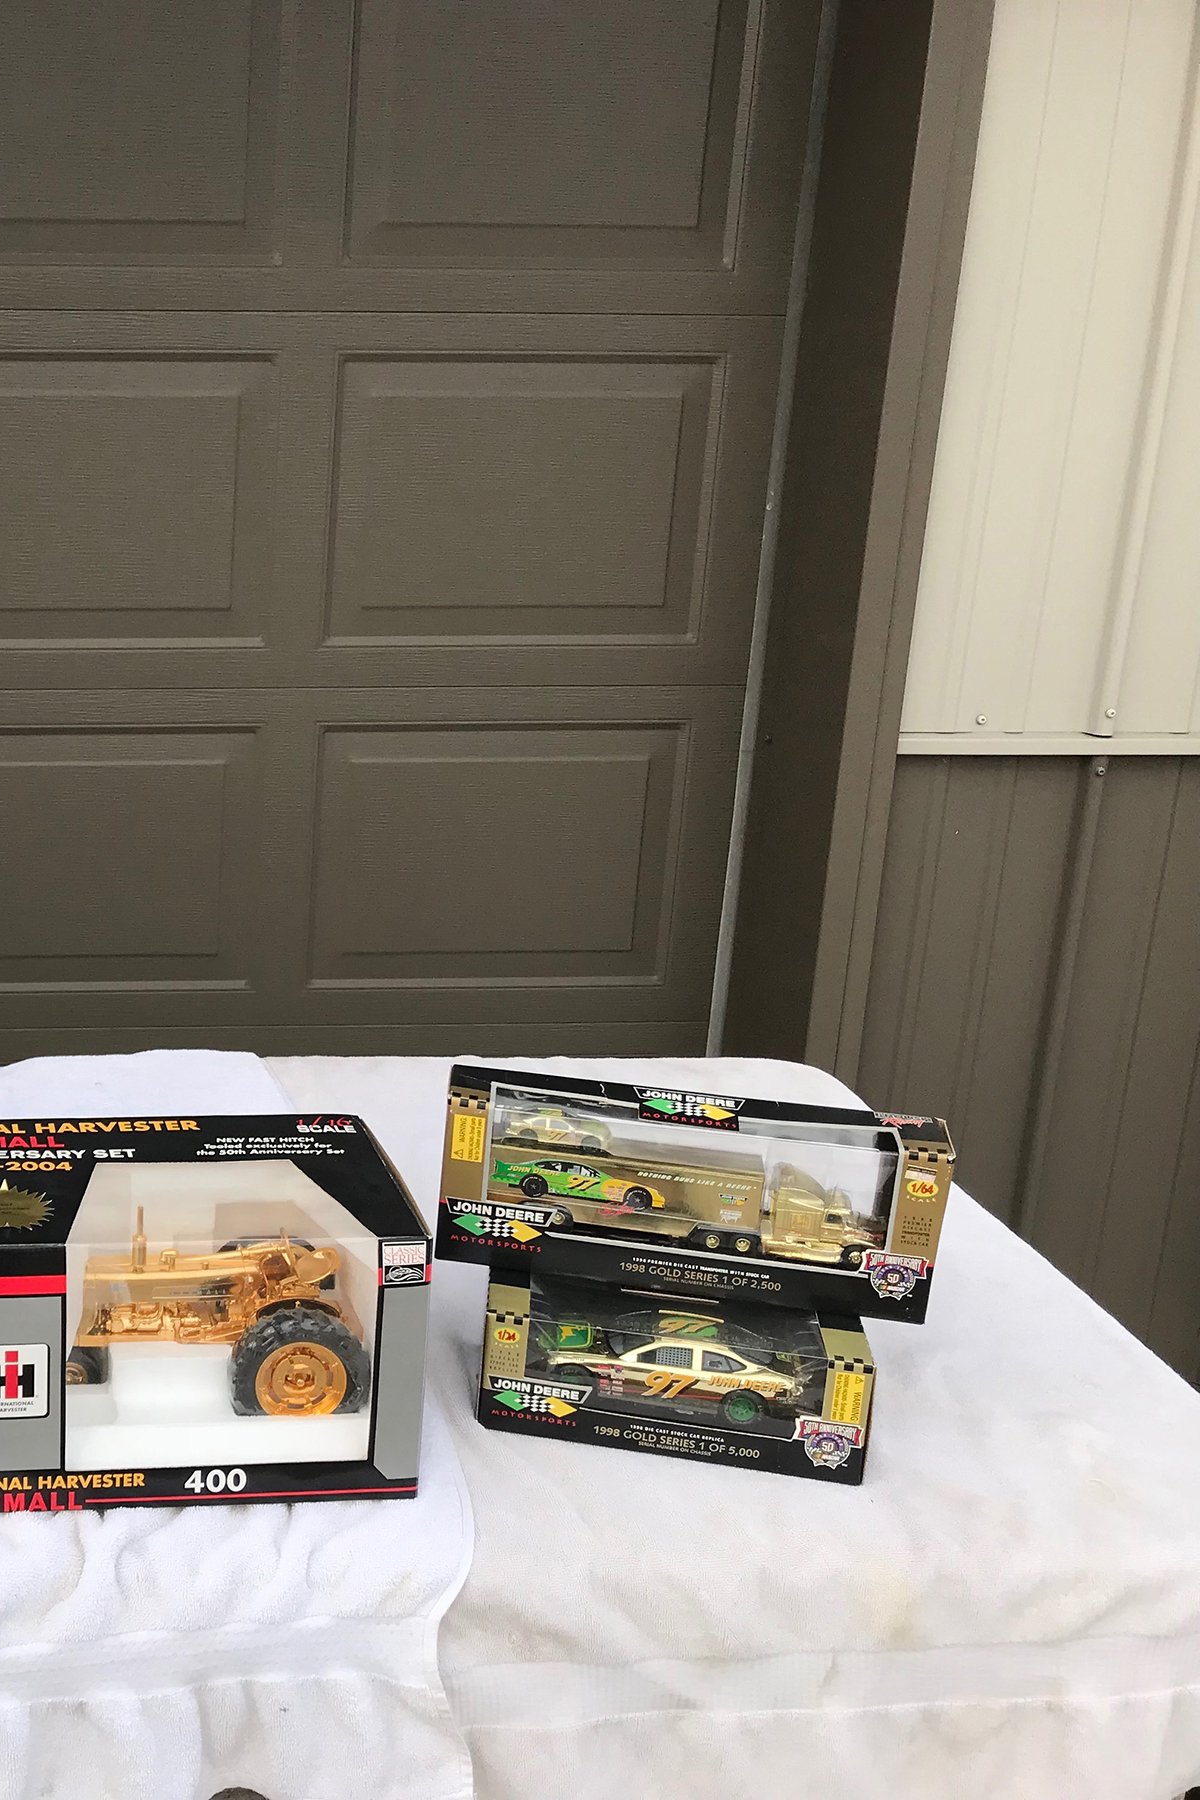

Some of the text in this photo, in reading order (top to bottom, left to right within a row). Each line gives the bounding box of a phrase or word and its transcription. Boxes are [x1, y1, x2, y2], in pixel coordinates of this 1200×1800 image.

[642, 1090, 735, 1107] JOHN DEERE
[35, 1119, 200, 1134] HARVESTER
[296, 1115, 352, 1127] 1/16
[642, 1112, 737, 1128] MOTORSPORTS
[296, 1125, 357, 1133] SCALE
[93, 1148, 136, 1159] SET
[507, 1165, 531, 1173] JOHN
[637, 1171, 672, 1180] NOTHING
[567, 1174, 600, 1191] 97
[911, 1182, 934, 1195] 1/64
[453, 1201, 544, 1222] JOHN DEERE
[384, 1246, 424, 1256] CLASSIC
[451, 1234, 542, 1253] MOTORSPORTS
[384, 1254, 424, 1264] SERIES
[619, 1262, 781, 1291] 1998 GOLD SERIES 1 OF 2,500
[887, 1273, 900, 1284] 50
[658, 1318, 716, 1334] 97
[497, 1329, 516, 1341] 1/24
[494, 1379, 580, 1401] JOHN DEERE
[641, 1371, 698, 1399] 97
[708, 1375, 785, 1393] JOHN DEERE
[851, 1392, 862, 1421] WARNING
[491, 1409, 577, 1427] MOTORSPORTS
[593, 1425, 760, 1458] 1998 GOLD SERIES 1 OF 5,000
[702, 1435, 725, 1443] REPLICA
[822, 1442, 834, 1452] 50
[38, 1472, 145, 1490] HARVESTER
[184, 1468, 247, 1493] 400
